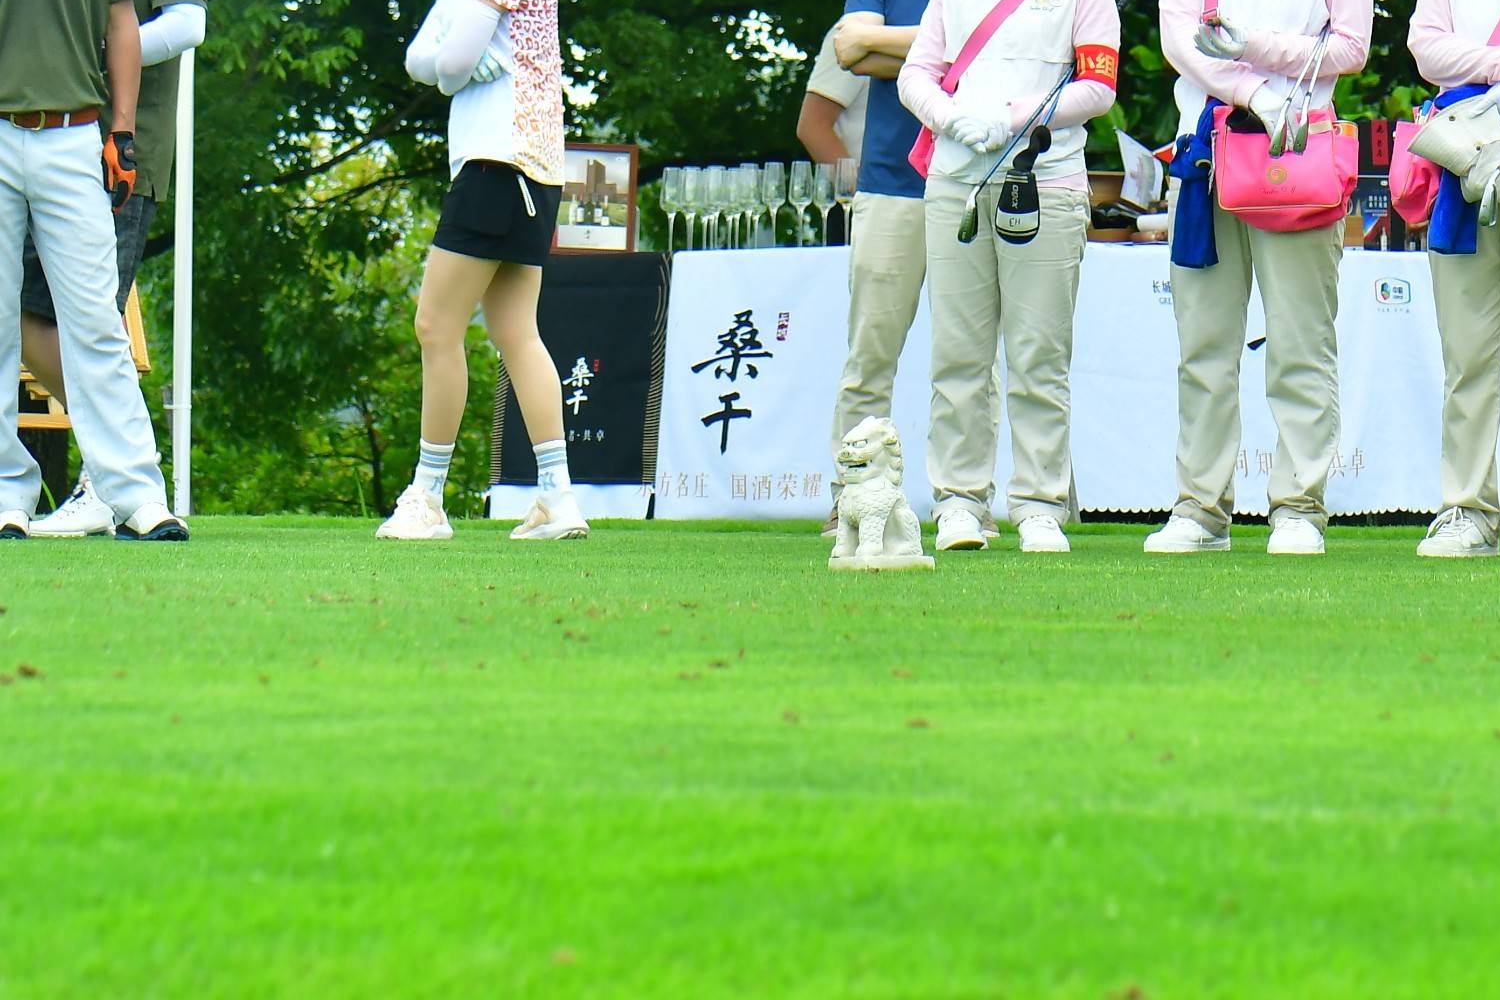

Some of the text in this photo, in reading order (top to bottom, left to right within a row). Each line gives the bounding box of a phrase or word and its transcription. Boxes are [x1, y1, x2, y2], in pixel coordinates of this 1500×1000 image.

[562, 356, 595, 415] 桑干
[691, 309, 773, 456] 桑干
[731, 472, 823, 501] 国酒荣耀
